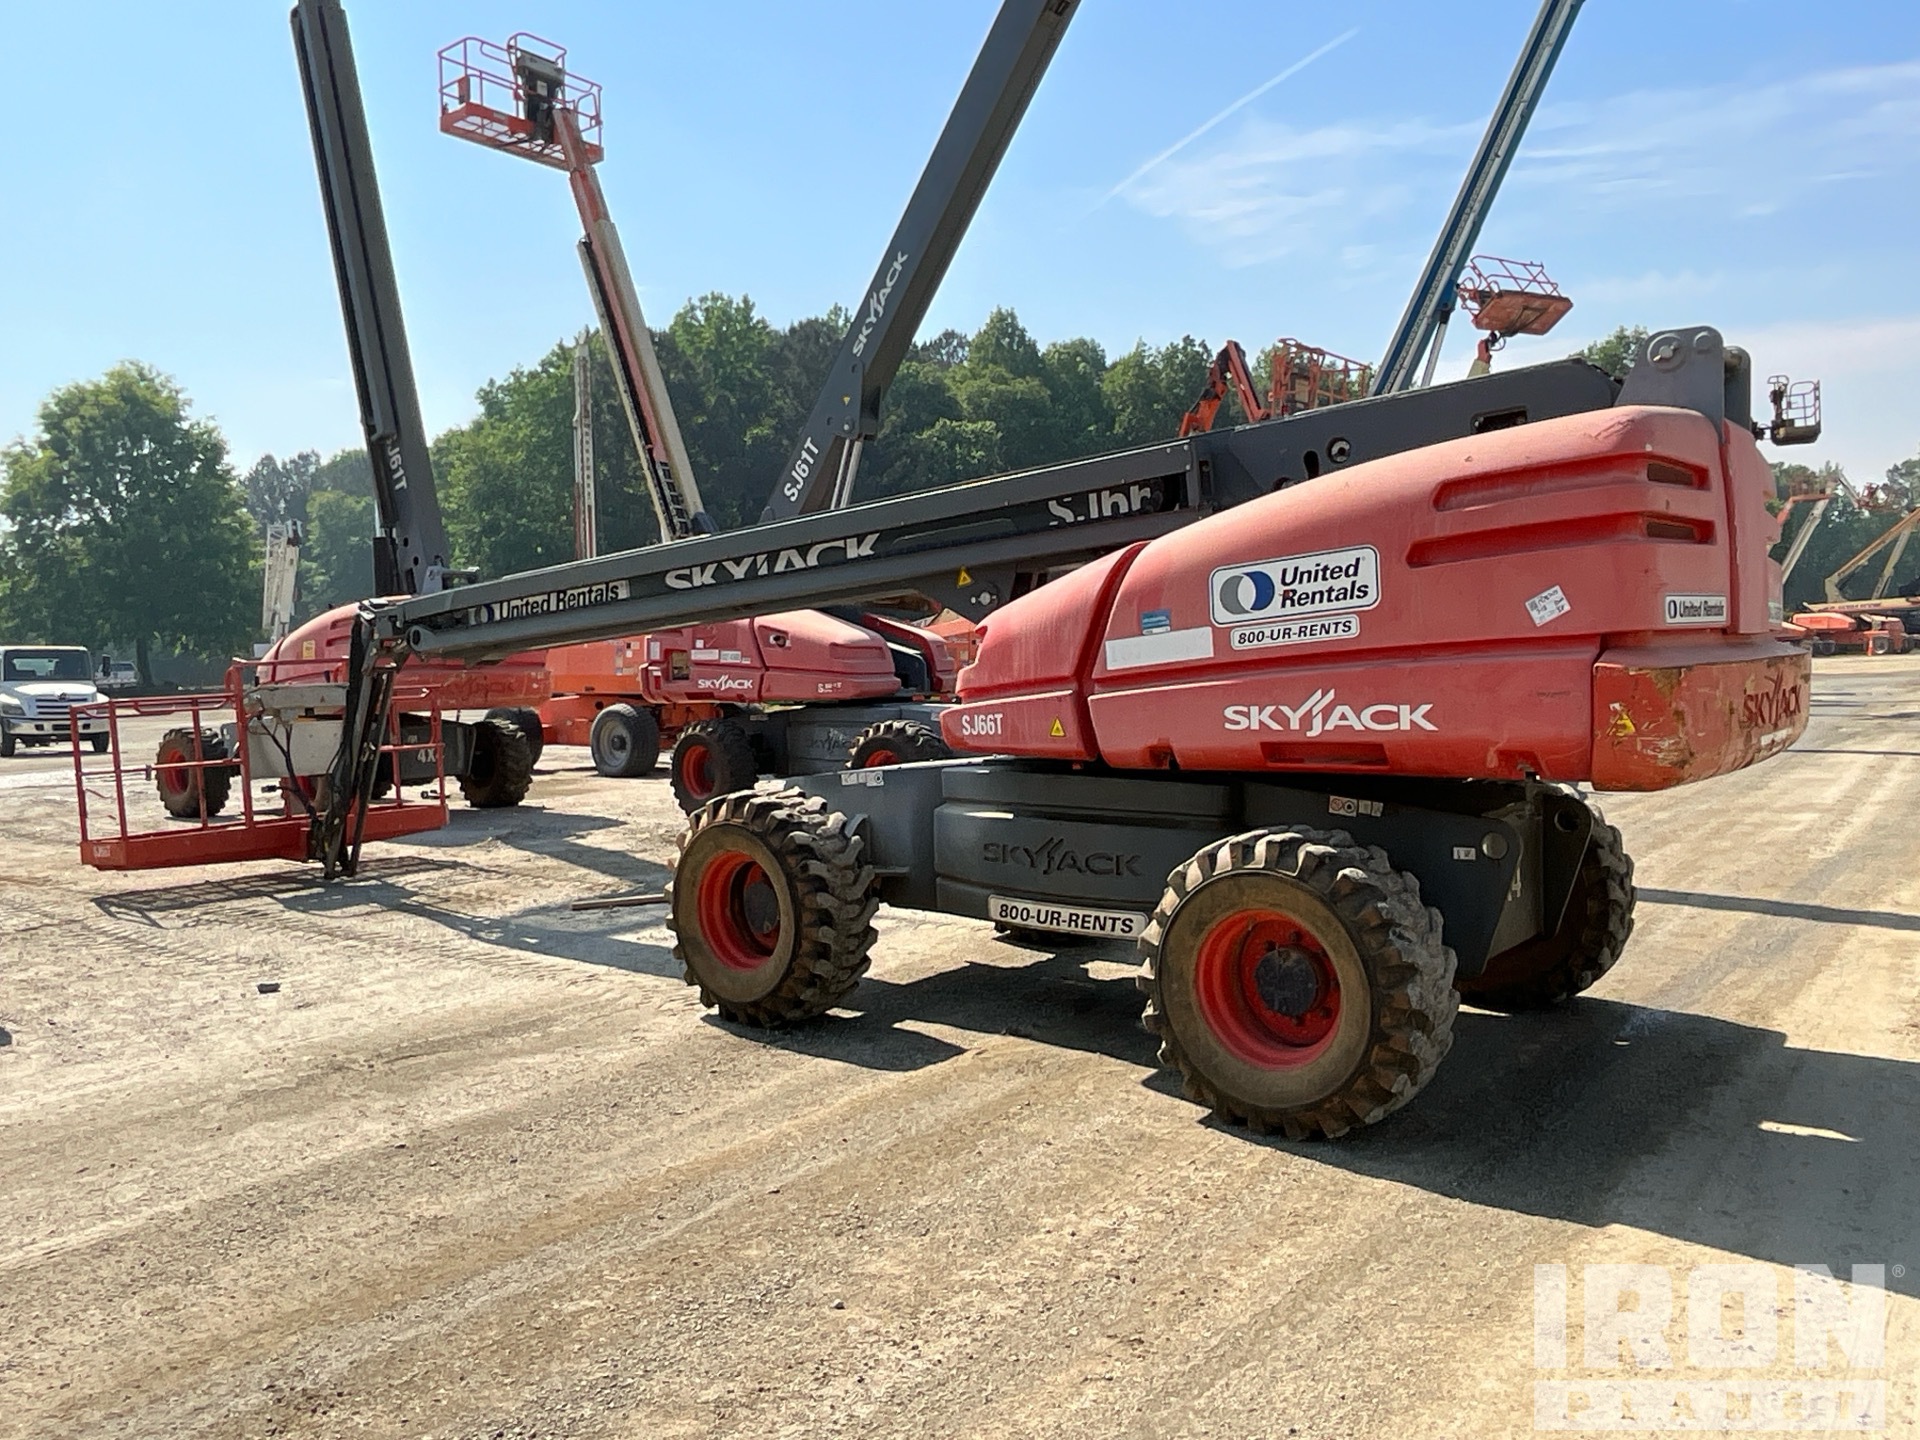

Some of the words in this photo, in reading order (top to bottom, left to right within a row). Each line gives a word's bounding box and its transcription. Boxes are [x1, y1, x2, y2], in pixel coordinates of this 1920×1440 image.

[852, 250, 909, 358] SKYJACK
[783, 436, 819, 502] SJ61T
[1280, 557, 1361, 586] United
[1280, 580, 1369, 609] Rentals
[1238, 620, 1352, 645] 800-UR-RENTS
[697, 674, 753, 691] SKYJACK
[961, 713, 1003, 735] SJ66T
[1223, 688, 1439, 737] SKYJACK
[983, 837, 1144, 877] SKYJACK
[999, 903, 1134, 935] 800-UR-RENTS
